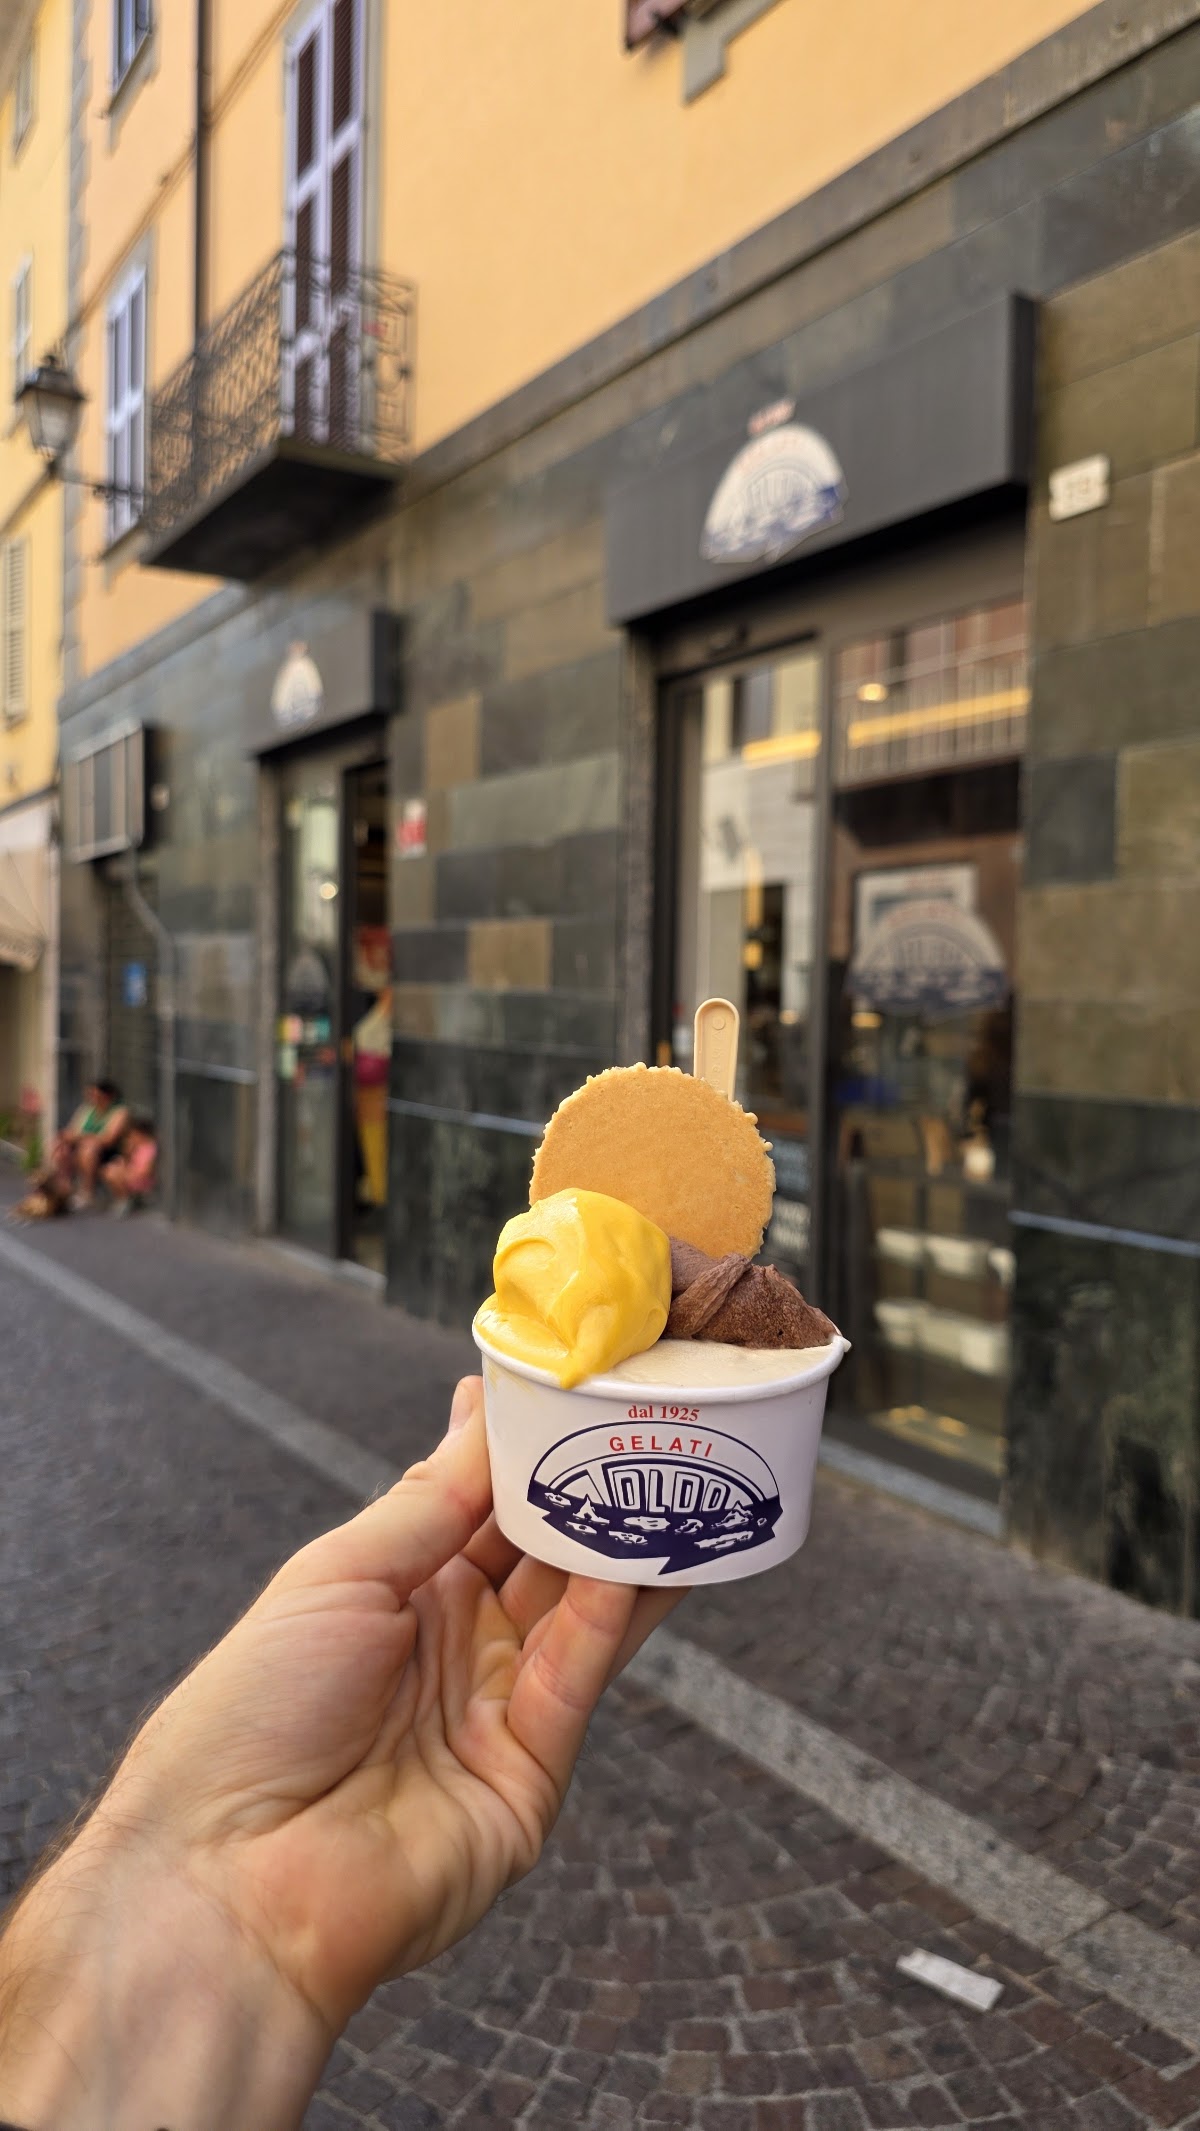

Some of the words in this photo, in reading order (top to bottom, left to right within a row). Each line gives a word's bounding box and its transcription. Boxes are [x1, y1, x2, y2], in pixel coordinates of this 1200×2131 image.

[628, 1404, 653, 1419] dal
[660, 1405, 700, 1422] 1925
[609, 1435, 712, 1457] GELATI
